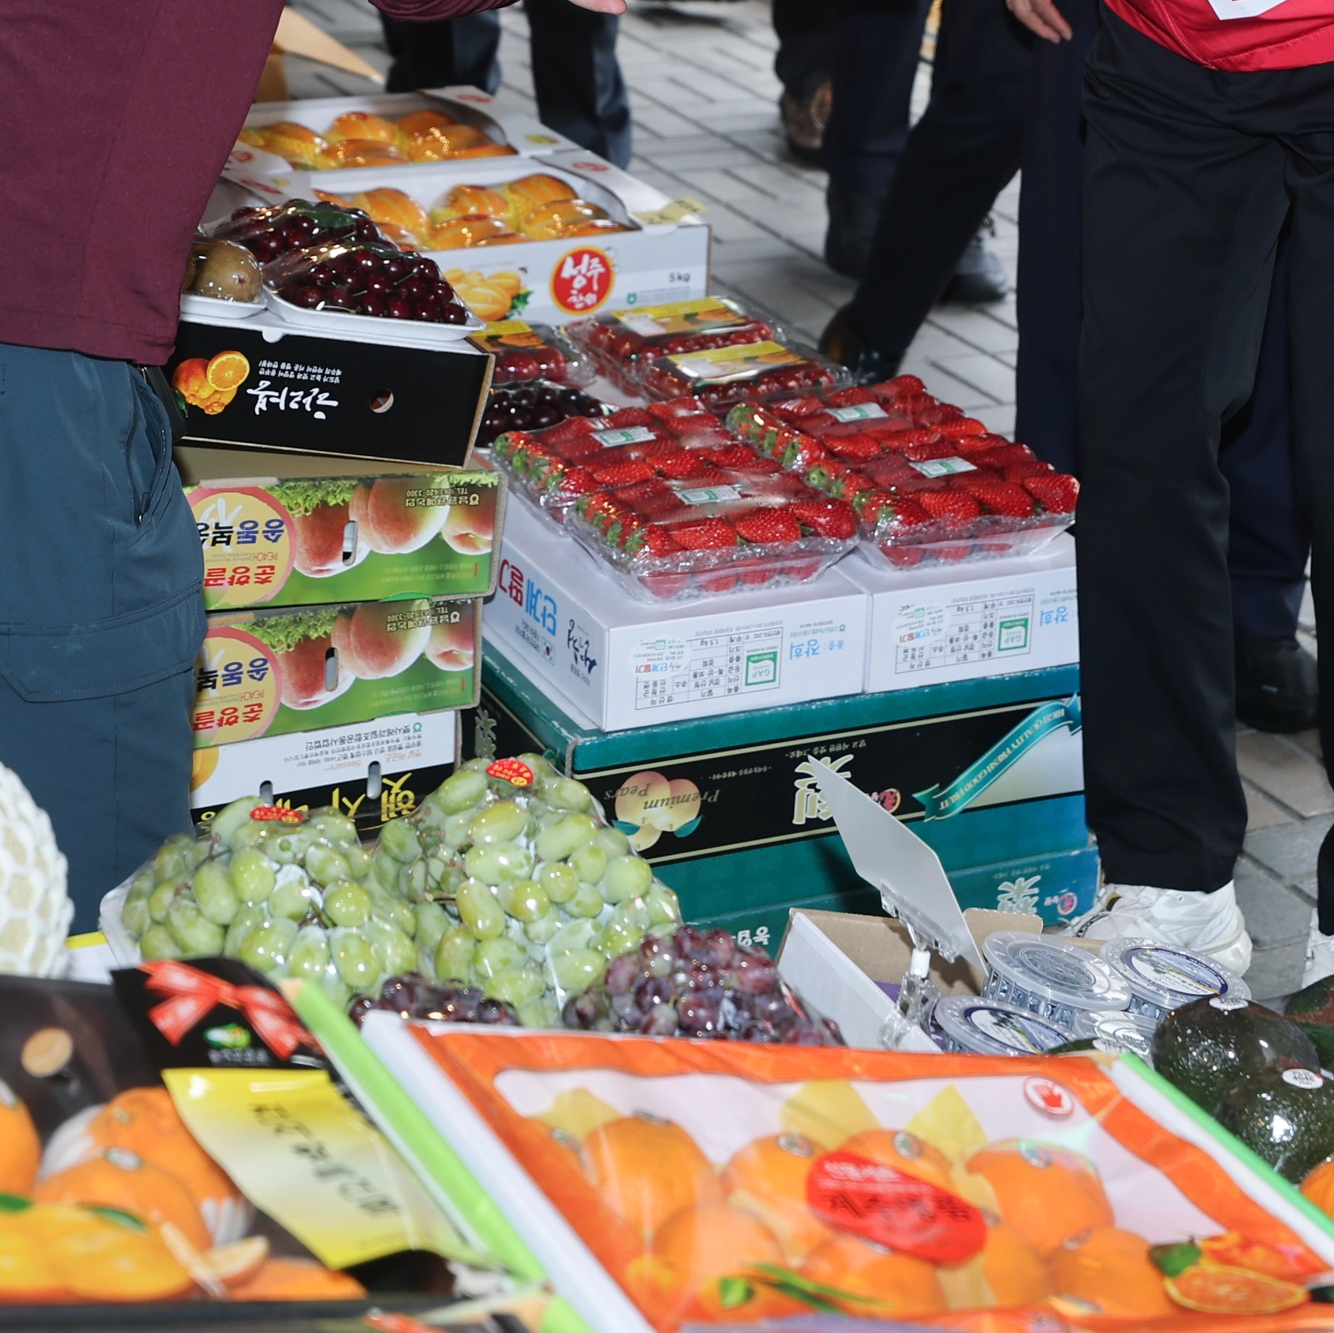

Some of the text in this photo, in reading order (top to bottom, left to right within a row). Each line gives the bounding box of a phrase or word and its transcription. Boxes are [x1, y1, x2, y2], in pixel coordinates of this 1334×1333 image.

[561, 253, 605, 291] 성주
[246, 380, 339, 420] 한라봉
[406, 494, 469, 508] 남원원예농협
[253, 551, 278, 561] PEACH
[204, 565, 276, 587] 춘향골
[499, 558, 524, 608] 딸기
[525, 578, 558, 637] 단계
[1039, 605, 1069, 627] 장희
[386, 611, 453, 632] 남원원예농협
[729, 635, 743, 644] 무게
[729, 645, 742, 654] 크기
[788, 637, 821, 661] 장희
[702, 655, 742, 667] 품종 장희
[728, 665, 741, 674] 등급
[195, 658, 269, 691] 송동복
[708, 677, 721, 687] 경남
[727, 675, 740, 684] 산지
[751, 667, 770, 678] GAP
[674, 679, 687, 688] 주소
[694, 680, 706, 689] 산청
[700, 689, 714, 698] 딸기
[240, 689, 265, 701] PEACH
[192, 702, 263, 731] 춘향골
[305, 724, 411, 752] 햇사레과일조합공동사업법인
[1010, 720, 1043, 751] QUALITY
[990, 748, 1011, 773] FRESH
[965, 766, 990, 792] GOOD
[604, 783, 652, 800] Pears
[643, 790, 720, 810] Premium
[939, 786, 966, 811] FRUIT
[730, 925, 771, 948] 농업
